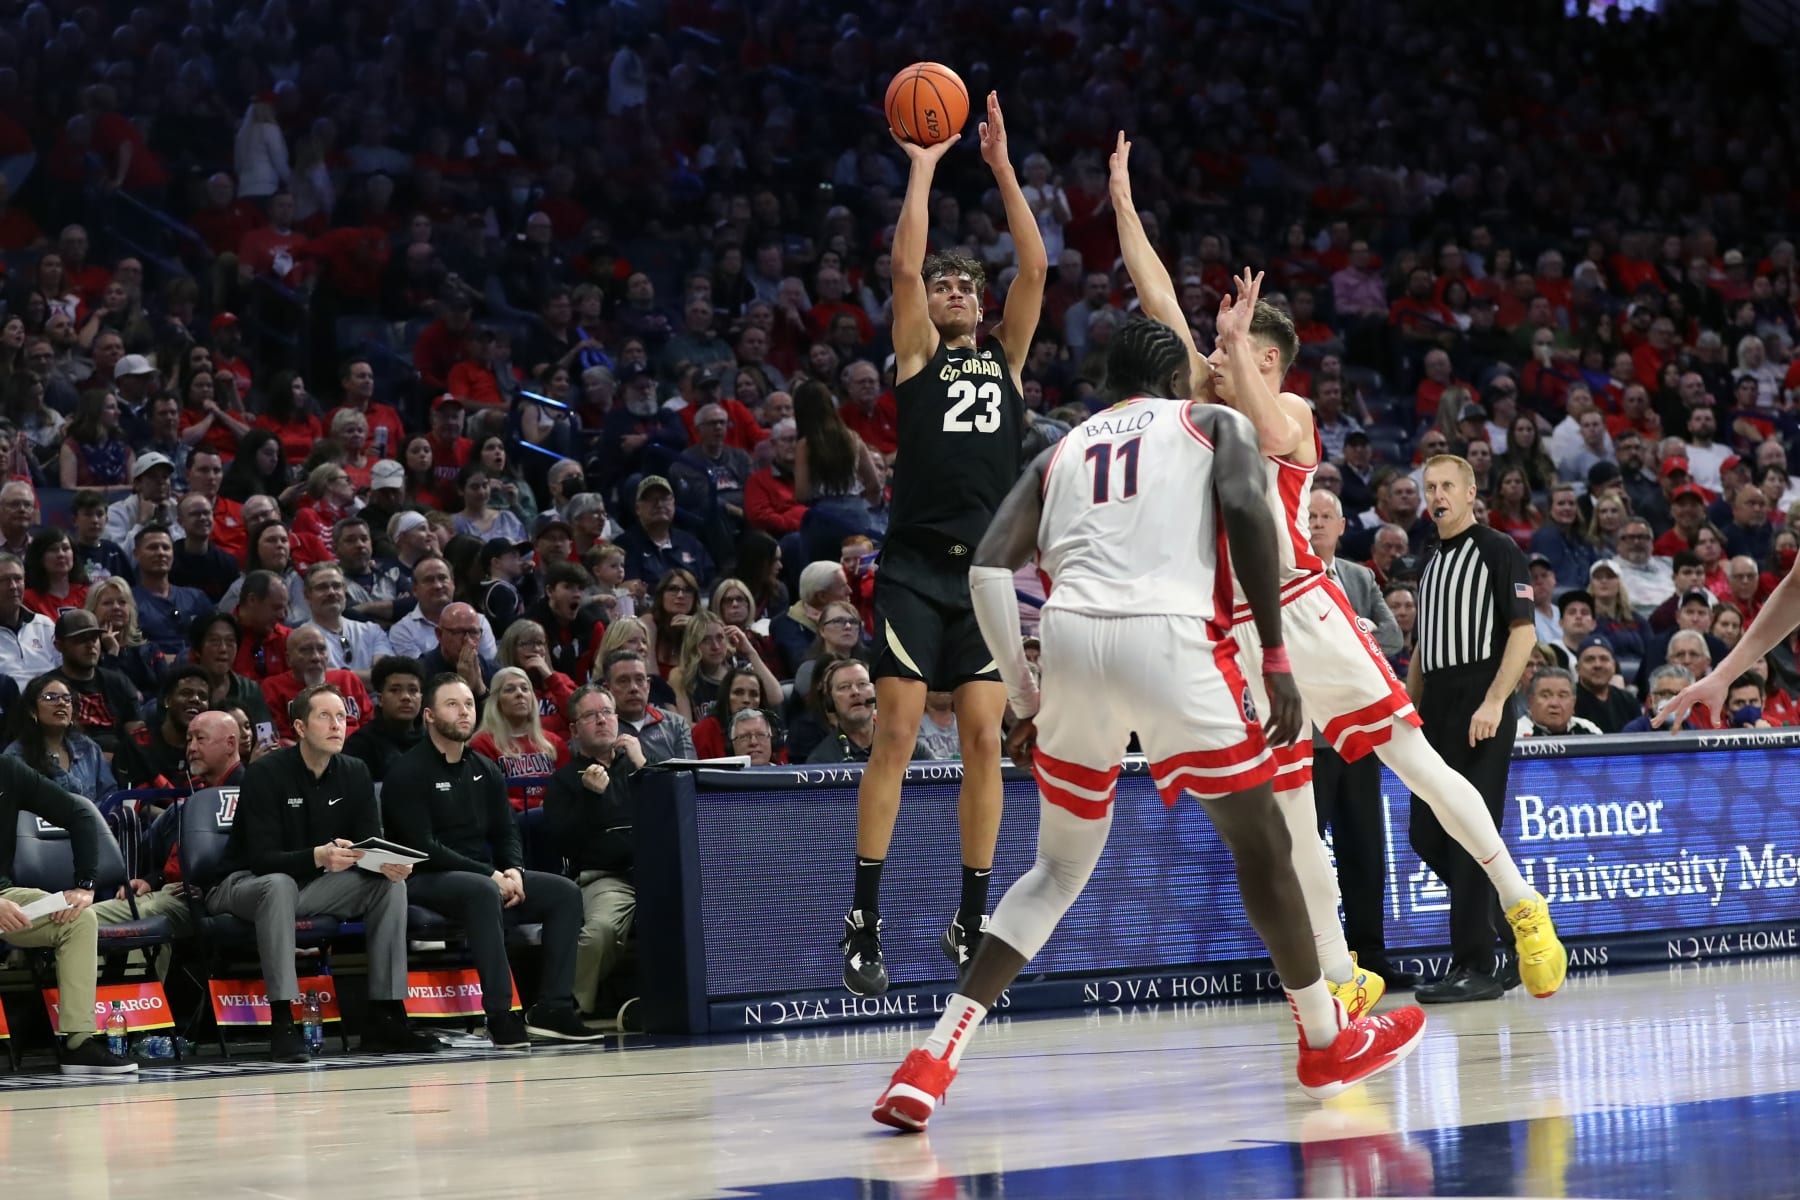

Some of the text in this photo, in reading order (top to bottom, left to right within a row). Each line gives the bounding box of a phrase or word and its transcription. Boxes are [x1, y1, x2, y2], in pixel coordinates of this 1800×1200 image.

[923, 108, 941, 139] CATS
[943, 380, 1002, 433] 23
[1086, 410, 1154, 437] BALLO
[1085, 436, 1142, 504] 11
[1520, 743, 1566, 756] LOANS
[1515, 796, 1664, 841] Banner
[1520, 849, 1730, 906] University
[1740, 928, 1797, 951] HOME
[408, 986, 456, 998] WELLS
[1172, 973, 1243, 998] HOME
[109, 996, 163, 1012] ARGO
[841, 994, 917, 1017] HOME
